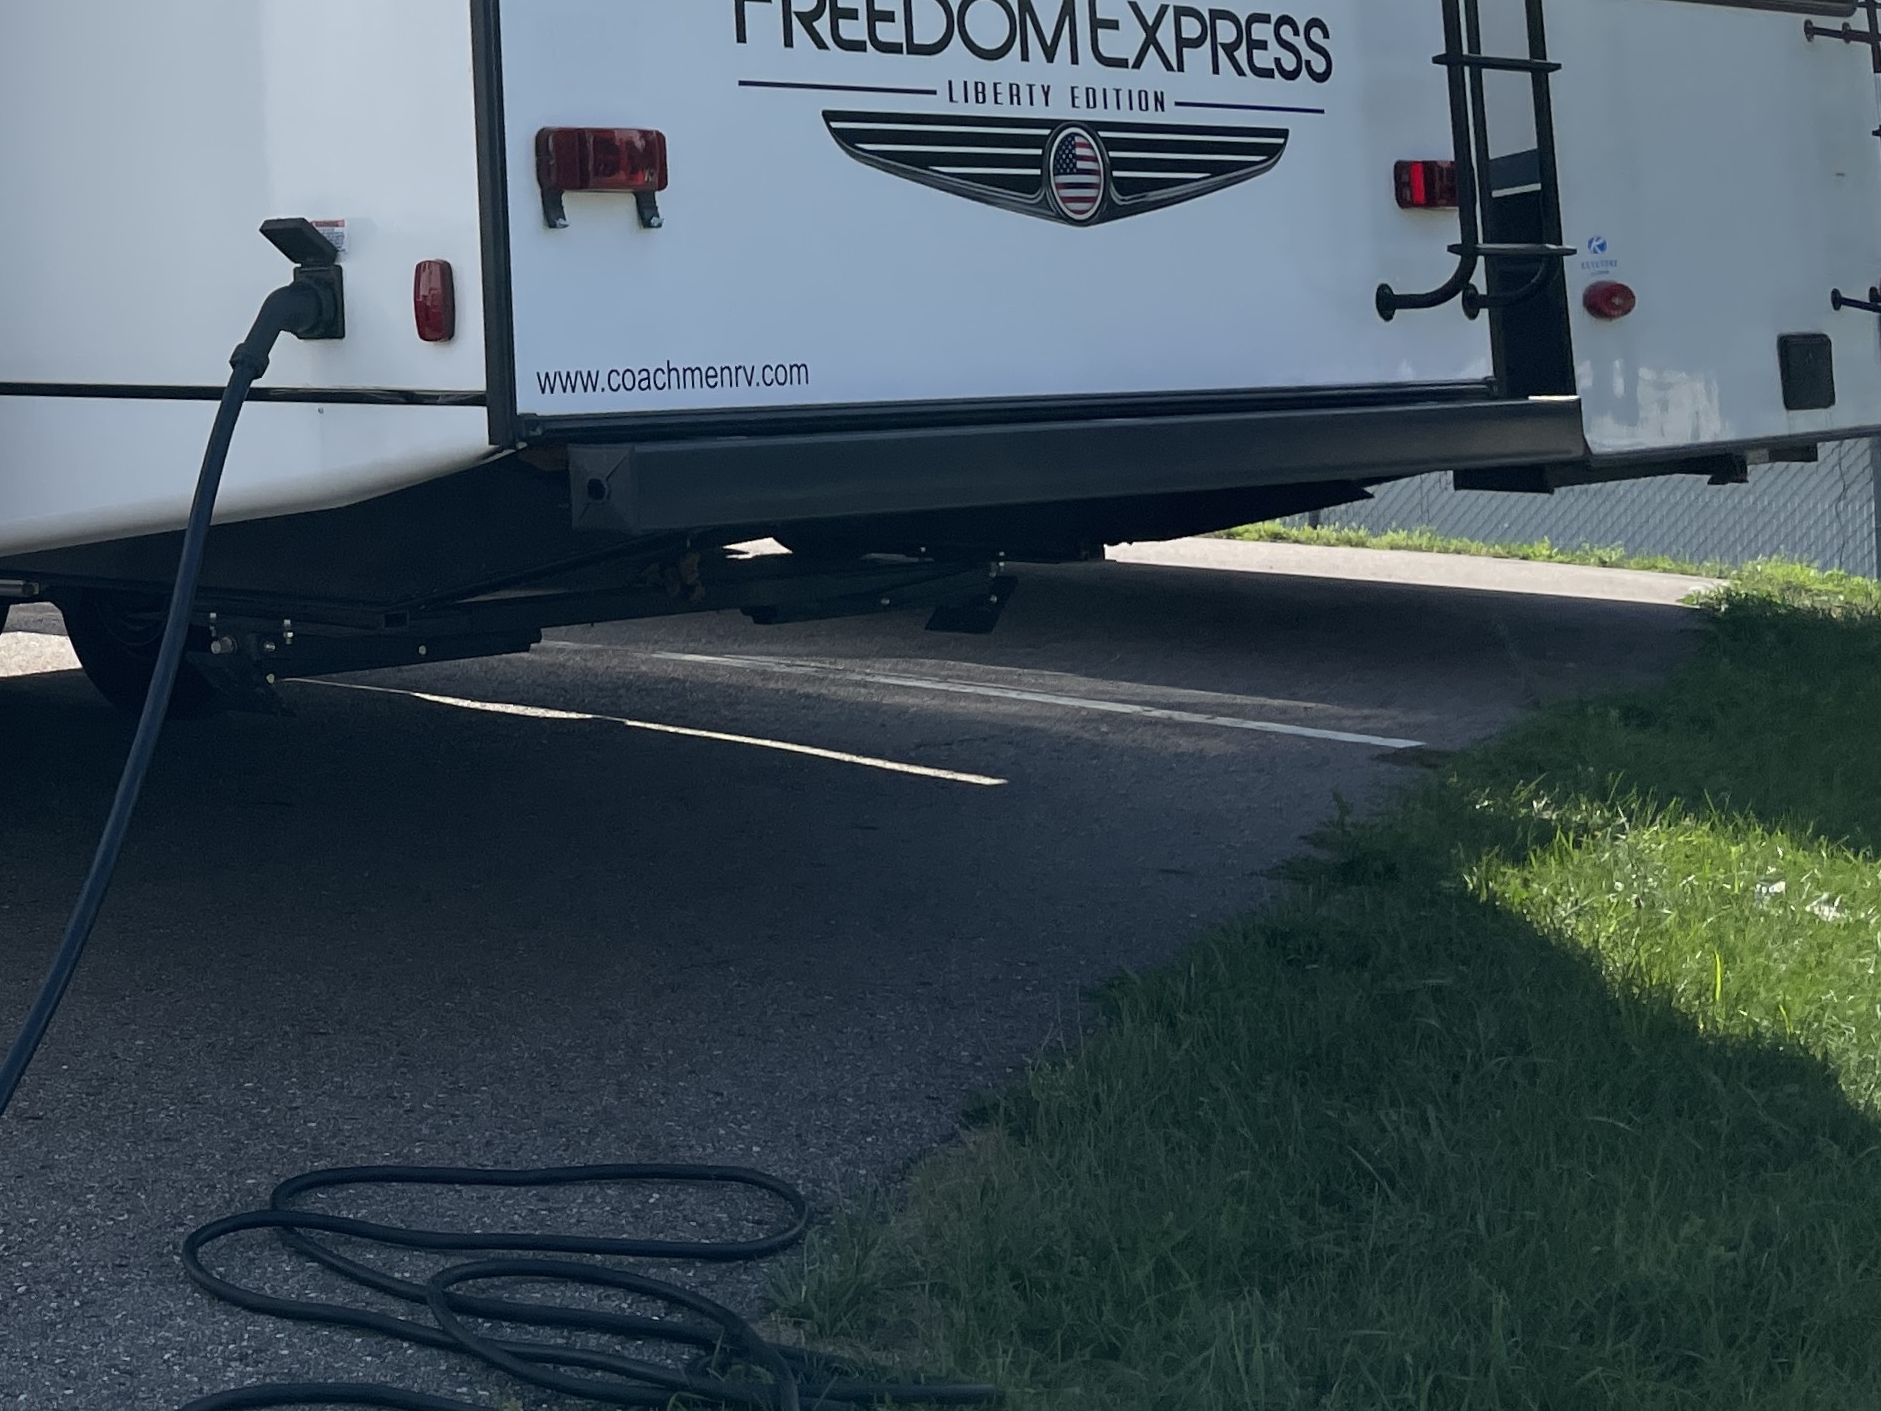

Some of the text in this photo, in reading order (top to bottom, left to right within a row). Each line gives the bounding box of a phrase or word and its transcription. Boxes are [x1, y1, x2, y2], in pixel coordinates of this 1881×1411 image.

[947, 79, 1166, 112] LIBERTY EDITION
[536, 359, 810, 395] www.coachmenrv.com
